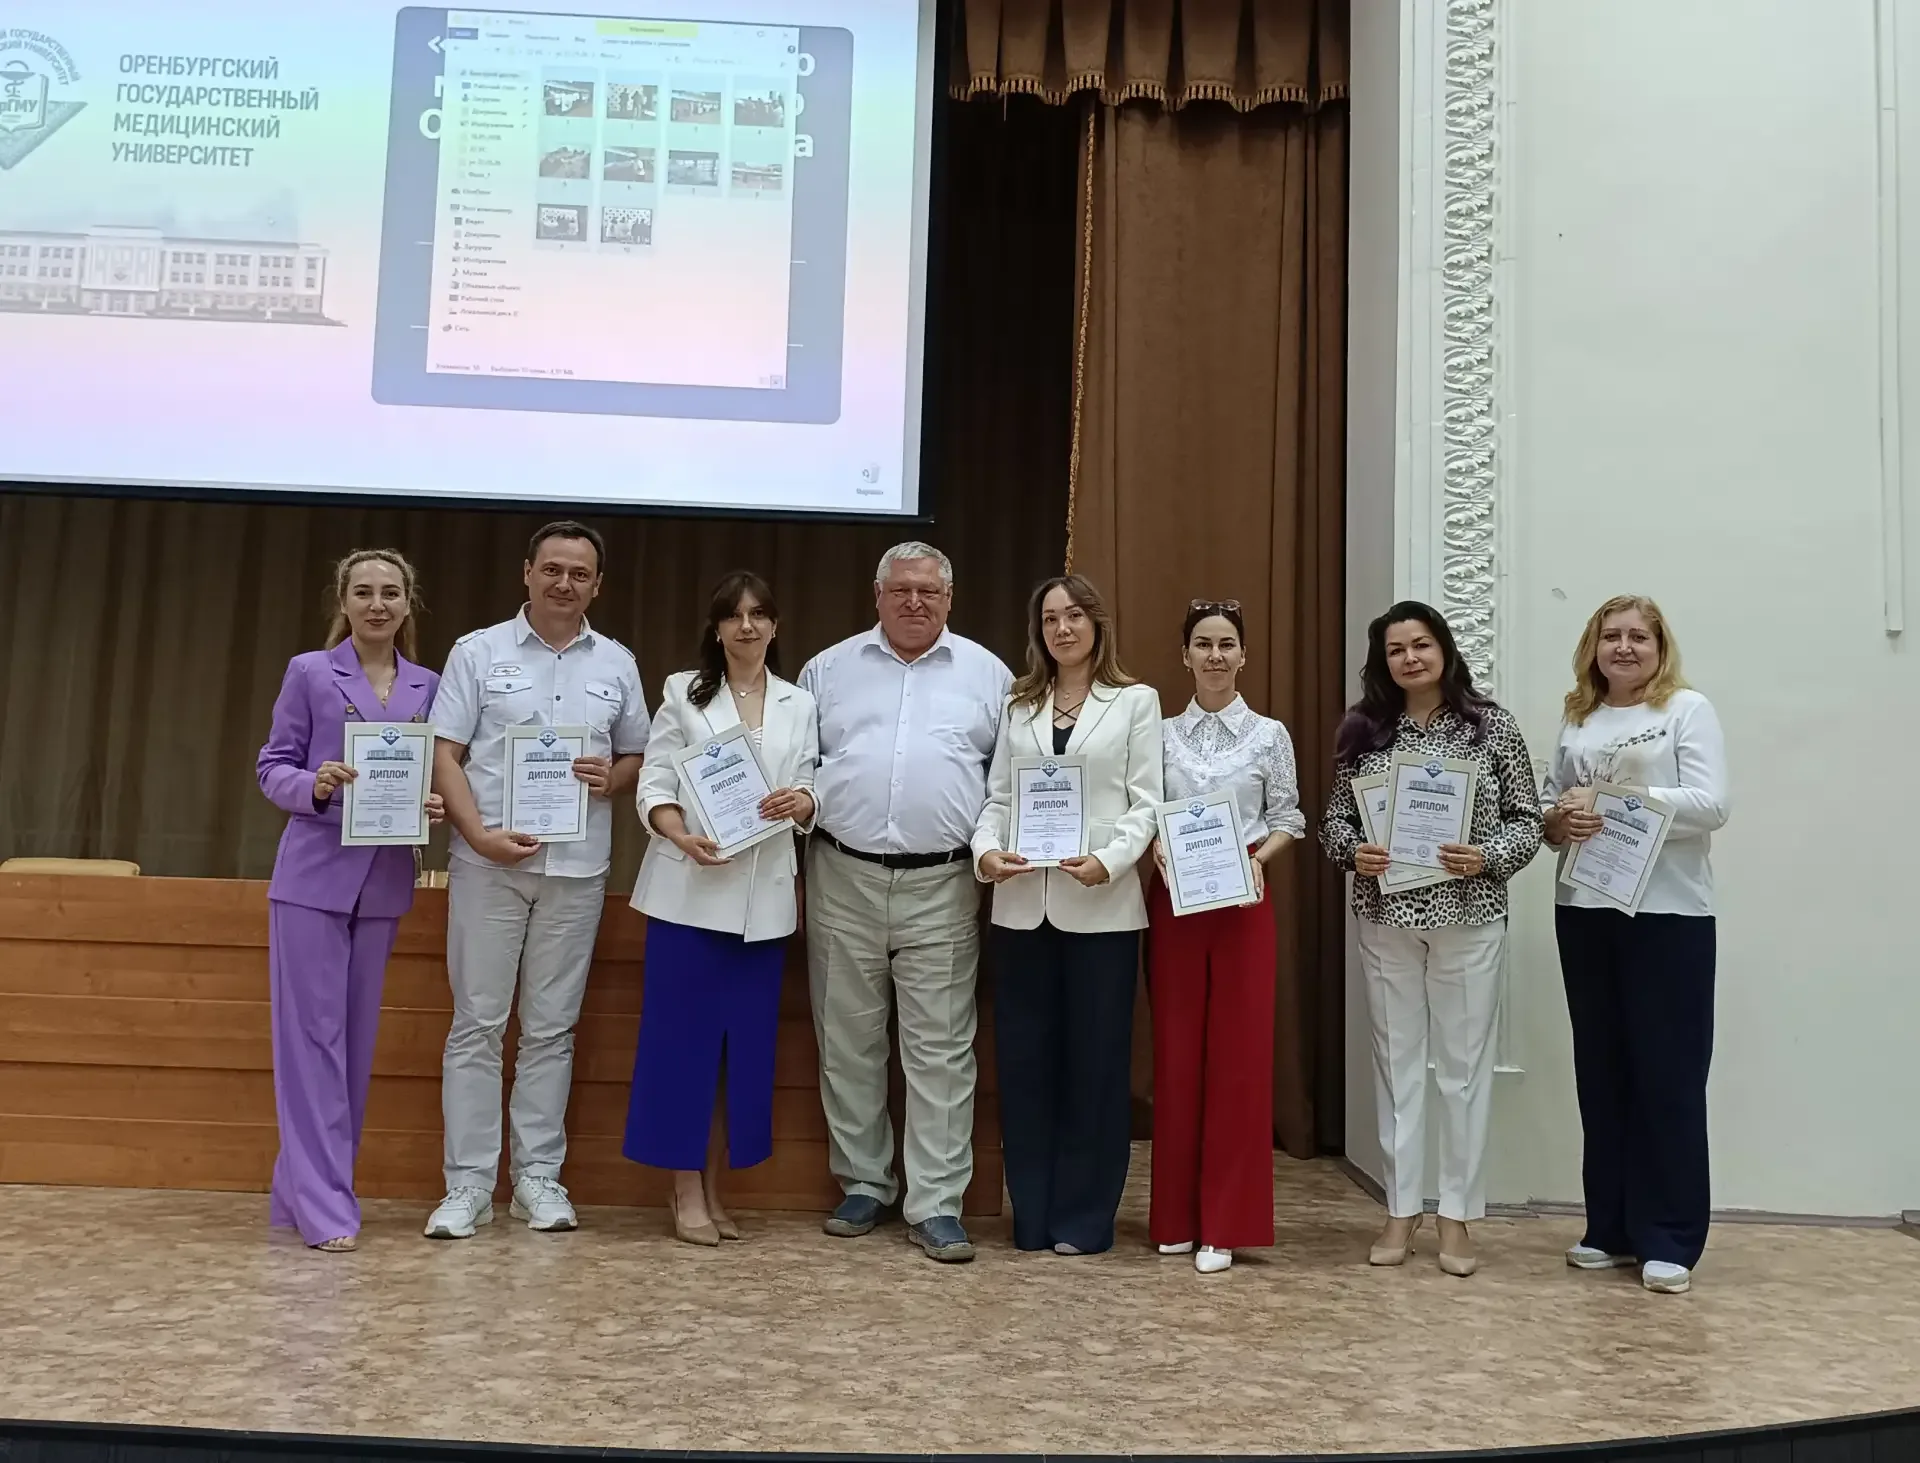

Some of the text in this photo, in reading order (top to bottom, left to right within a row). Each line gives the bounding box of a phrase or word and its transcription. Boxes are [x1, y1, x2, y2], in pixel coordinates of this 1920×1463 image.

[119, 53, 279, 80] ОРЕНБУРГСКИЙ
[116, 83, 320, 111] ГОСУДАРСТВЕННЫЙ
[0, 99, 37, 114] рГМУ
[113, 112, 281, 139] МЕДИЦИНСКИЙ
[112, 142, 254, 167] УНИВЕРСИТЕТ
[369, 769, 409, 780] ДИПЛОМ
[527, 770, 567, 781] ДИПЛОМ
[710, 771, 747, 795] ДИПЛОМ
[1032, 799, 1069, 811] ДИПЛОМ
[1409, 799, 1449, 813] ДИПЛОМ
[1185, 836, 1223, 852] ДИПЛОМ
[1600, 827, 1640, 848] ДИПЛОМ
